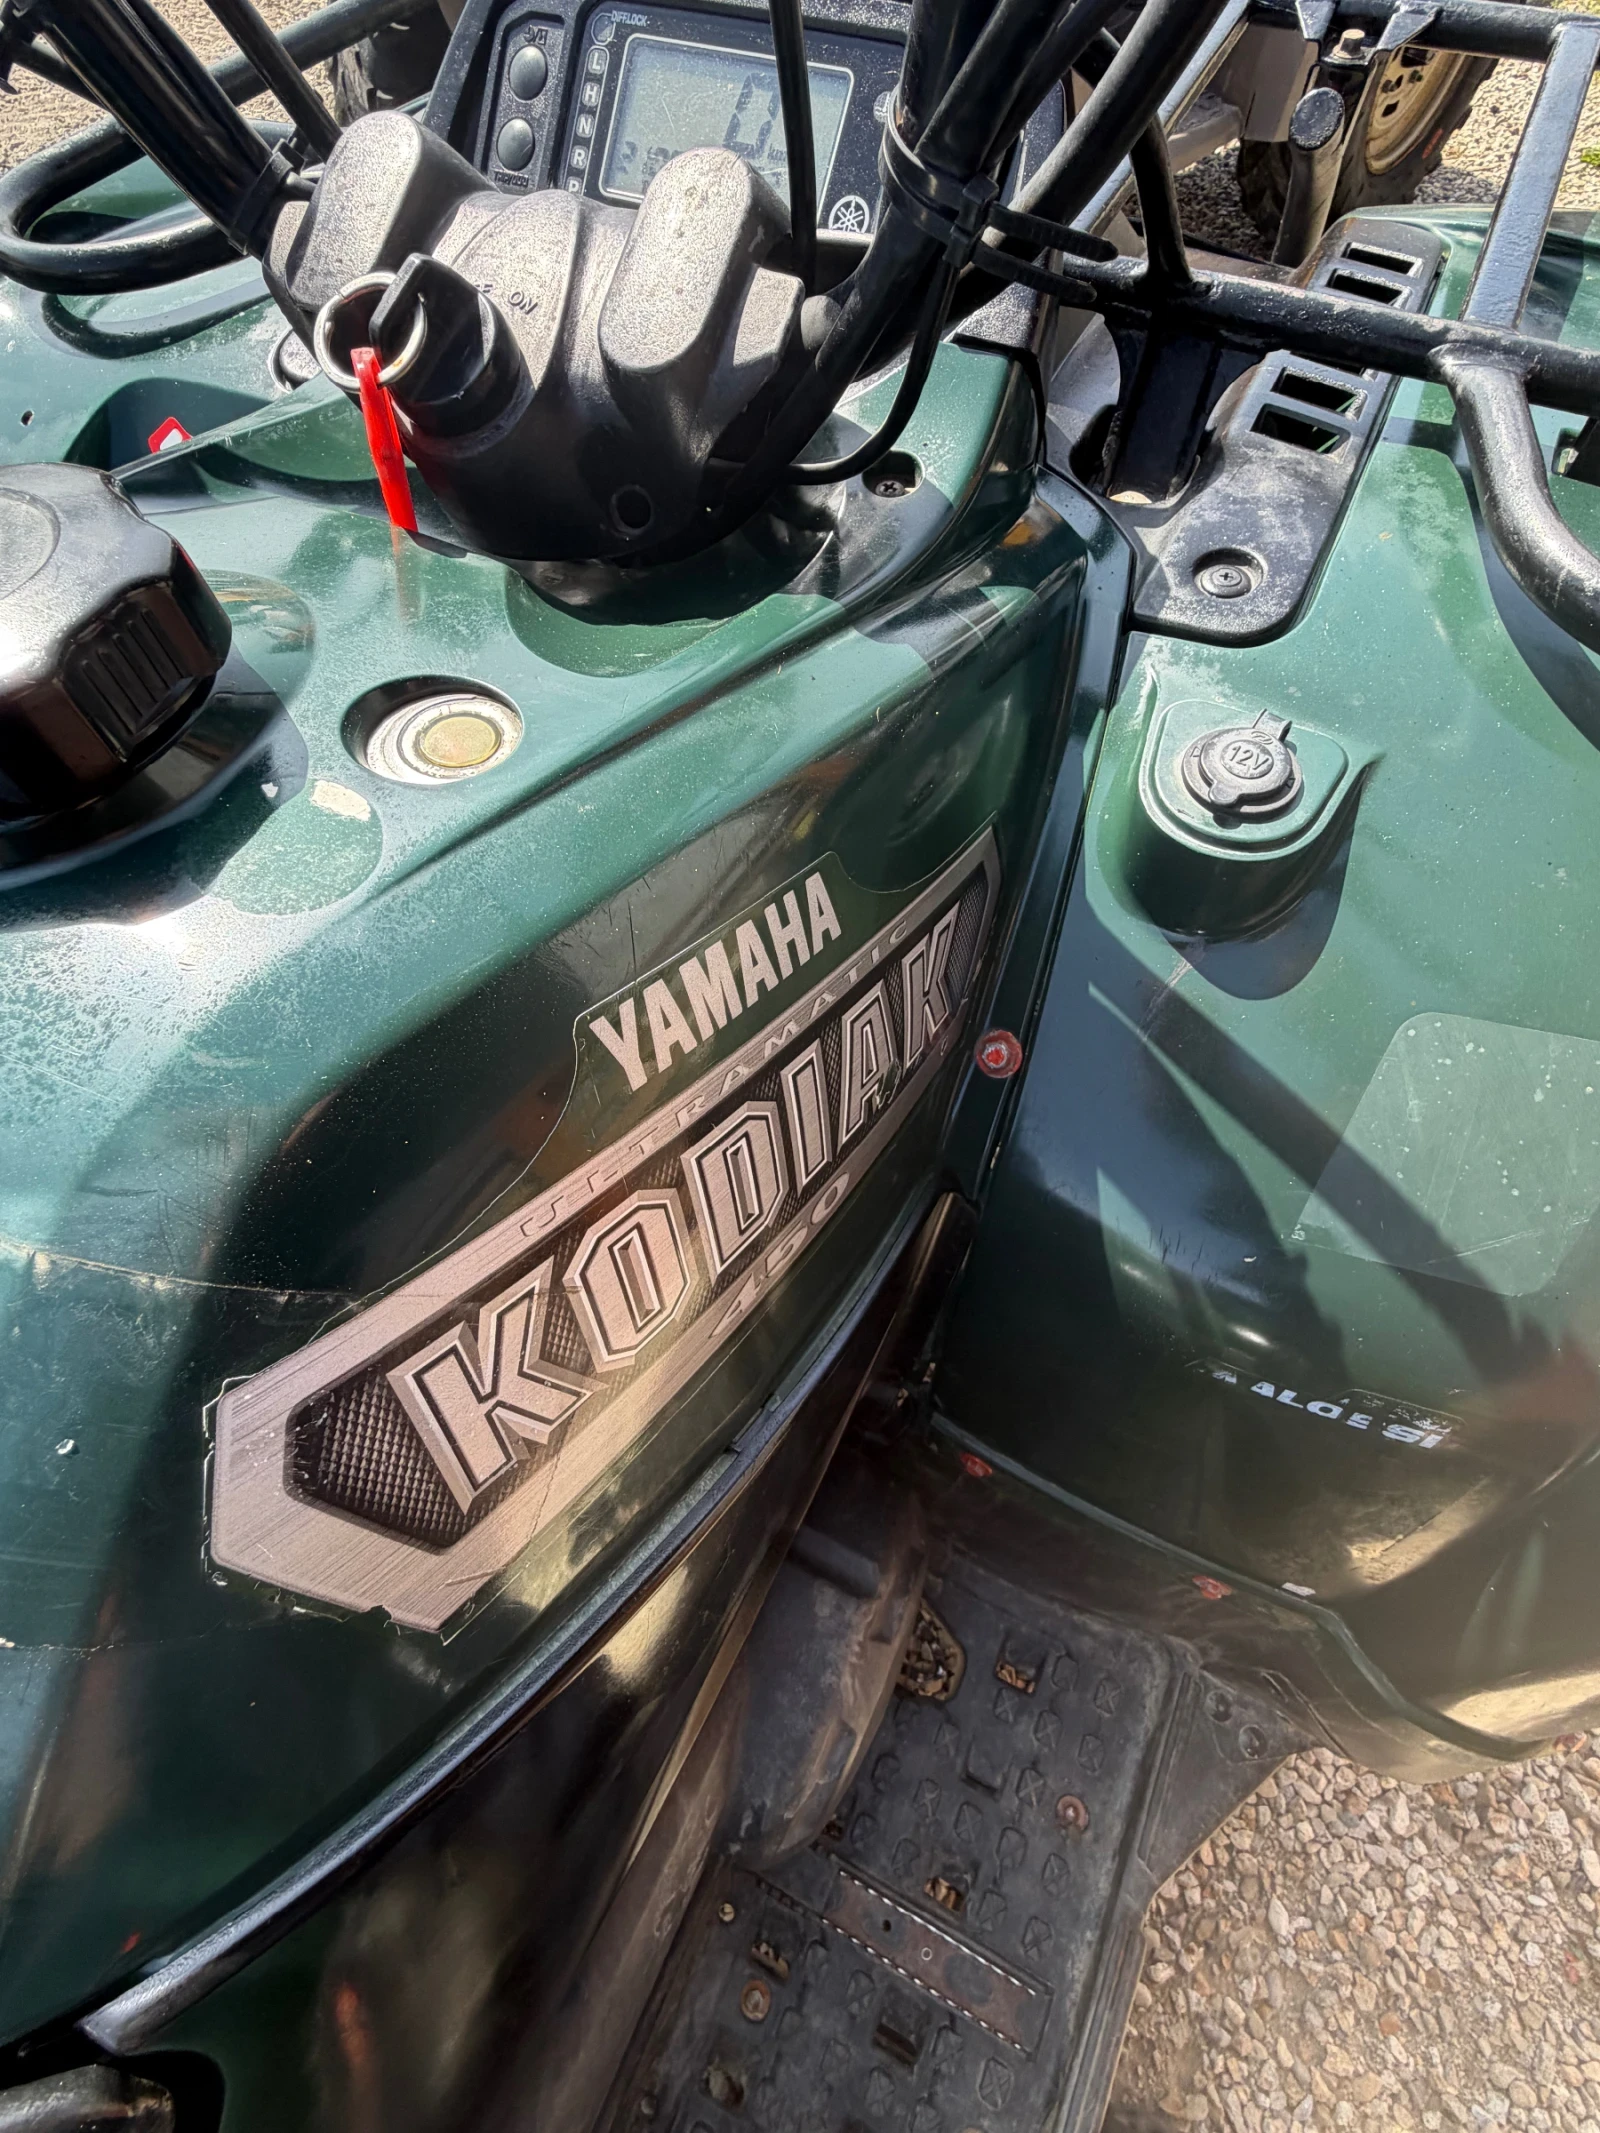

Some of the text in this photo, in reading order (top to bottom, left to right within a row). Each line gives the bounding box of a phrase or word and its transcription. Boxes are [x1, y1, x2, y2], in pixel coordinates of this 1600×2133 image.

[592, 52, 601, 70] L
[584, 84, 598, 103] H
[578, 114, 593, 135] N
[573, 148, 586, 166] R
[568, 179, 580, 193] P
[508, 291, 538, 315] ON
[1229, 745, 1270, 770] 12V
[589, 872, 842, 1092] YAMAHA
[519, 920, 908, 1239] ULTRAMATIC
[386, 899, 960, 1516] KODIAK
[708, 1171, 850, 1340] 450
